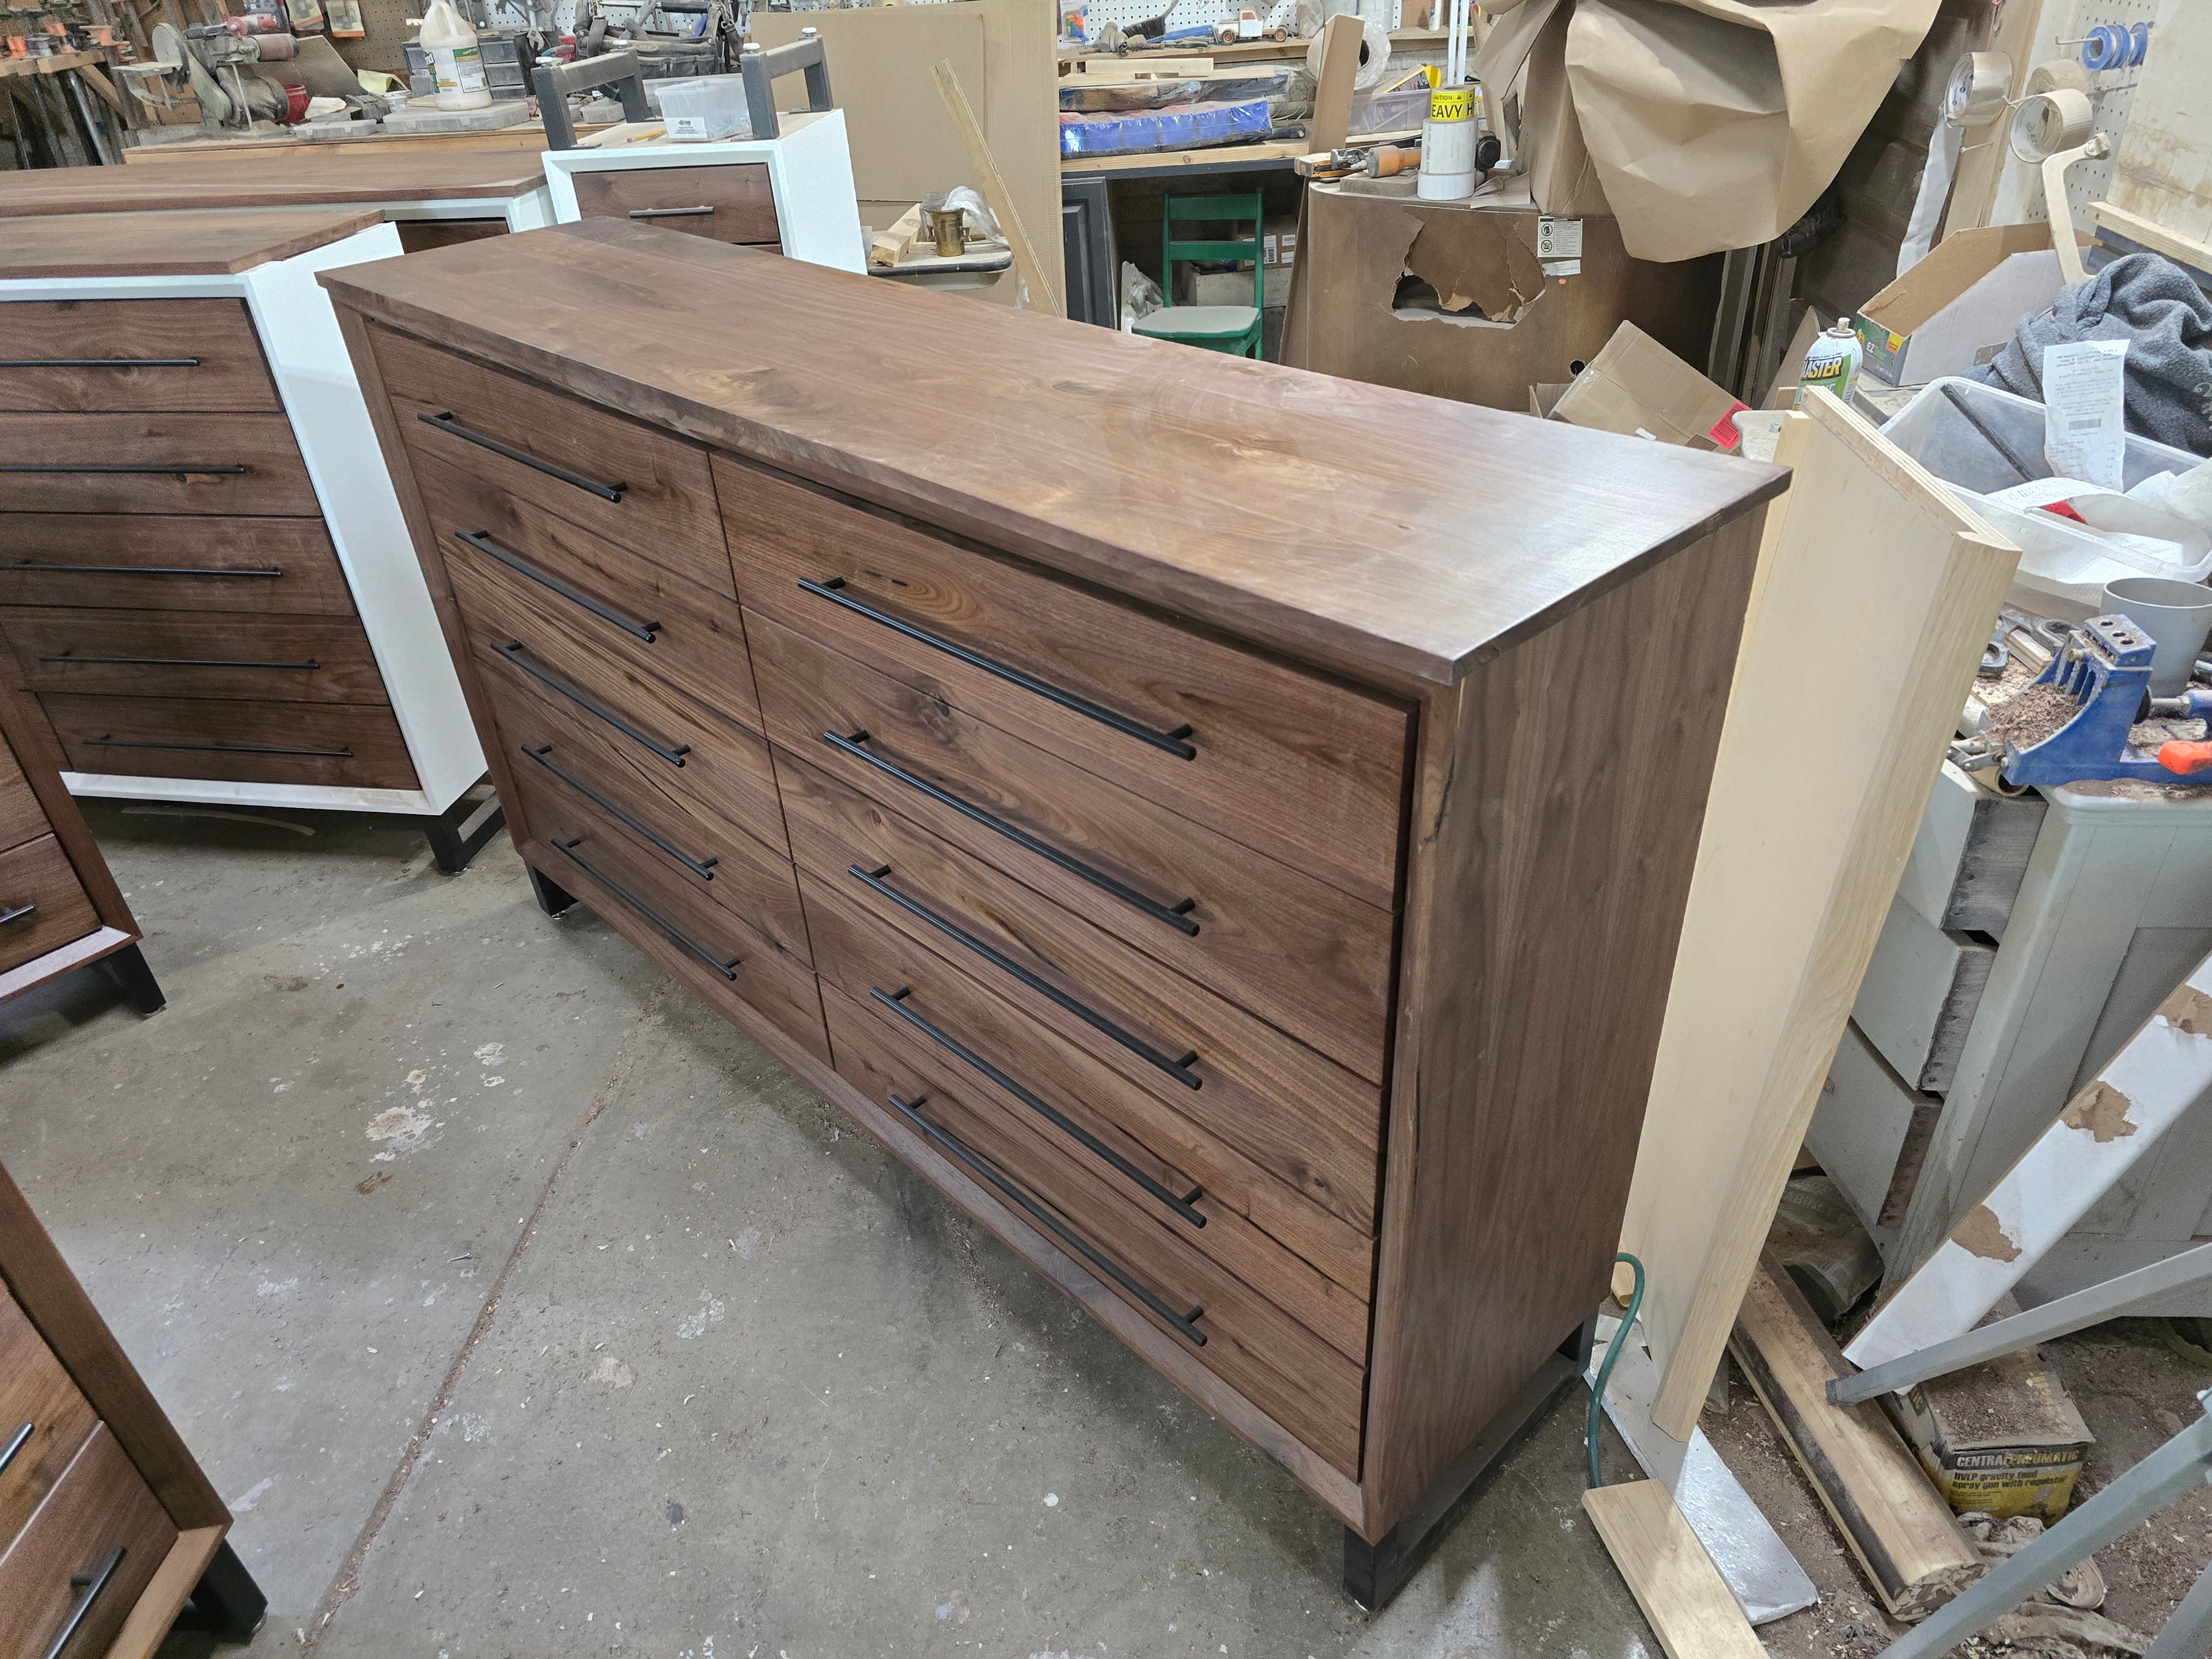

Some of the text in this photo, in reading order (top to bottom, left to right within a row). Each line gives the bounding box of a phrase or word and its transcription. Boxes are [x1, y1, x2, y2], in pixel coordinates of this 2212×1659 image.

[1431, 104, 1463, 118] EAVY
[1866, 341, 1876, 353] EZ
[1802, 357, 1842, 378] LASTER
[1957, 1455, 2008, 1467] CENTRAL
[1954, 1470, 2038, 1482] HVLP gravity feed
[1952, 1480, 1980, 1489] spray
[2002, 1479, 2023, 1488] with
